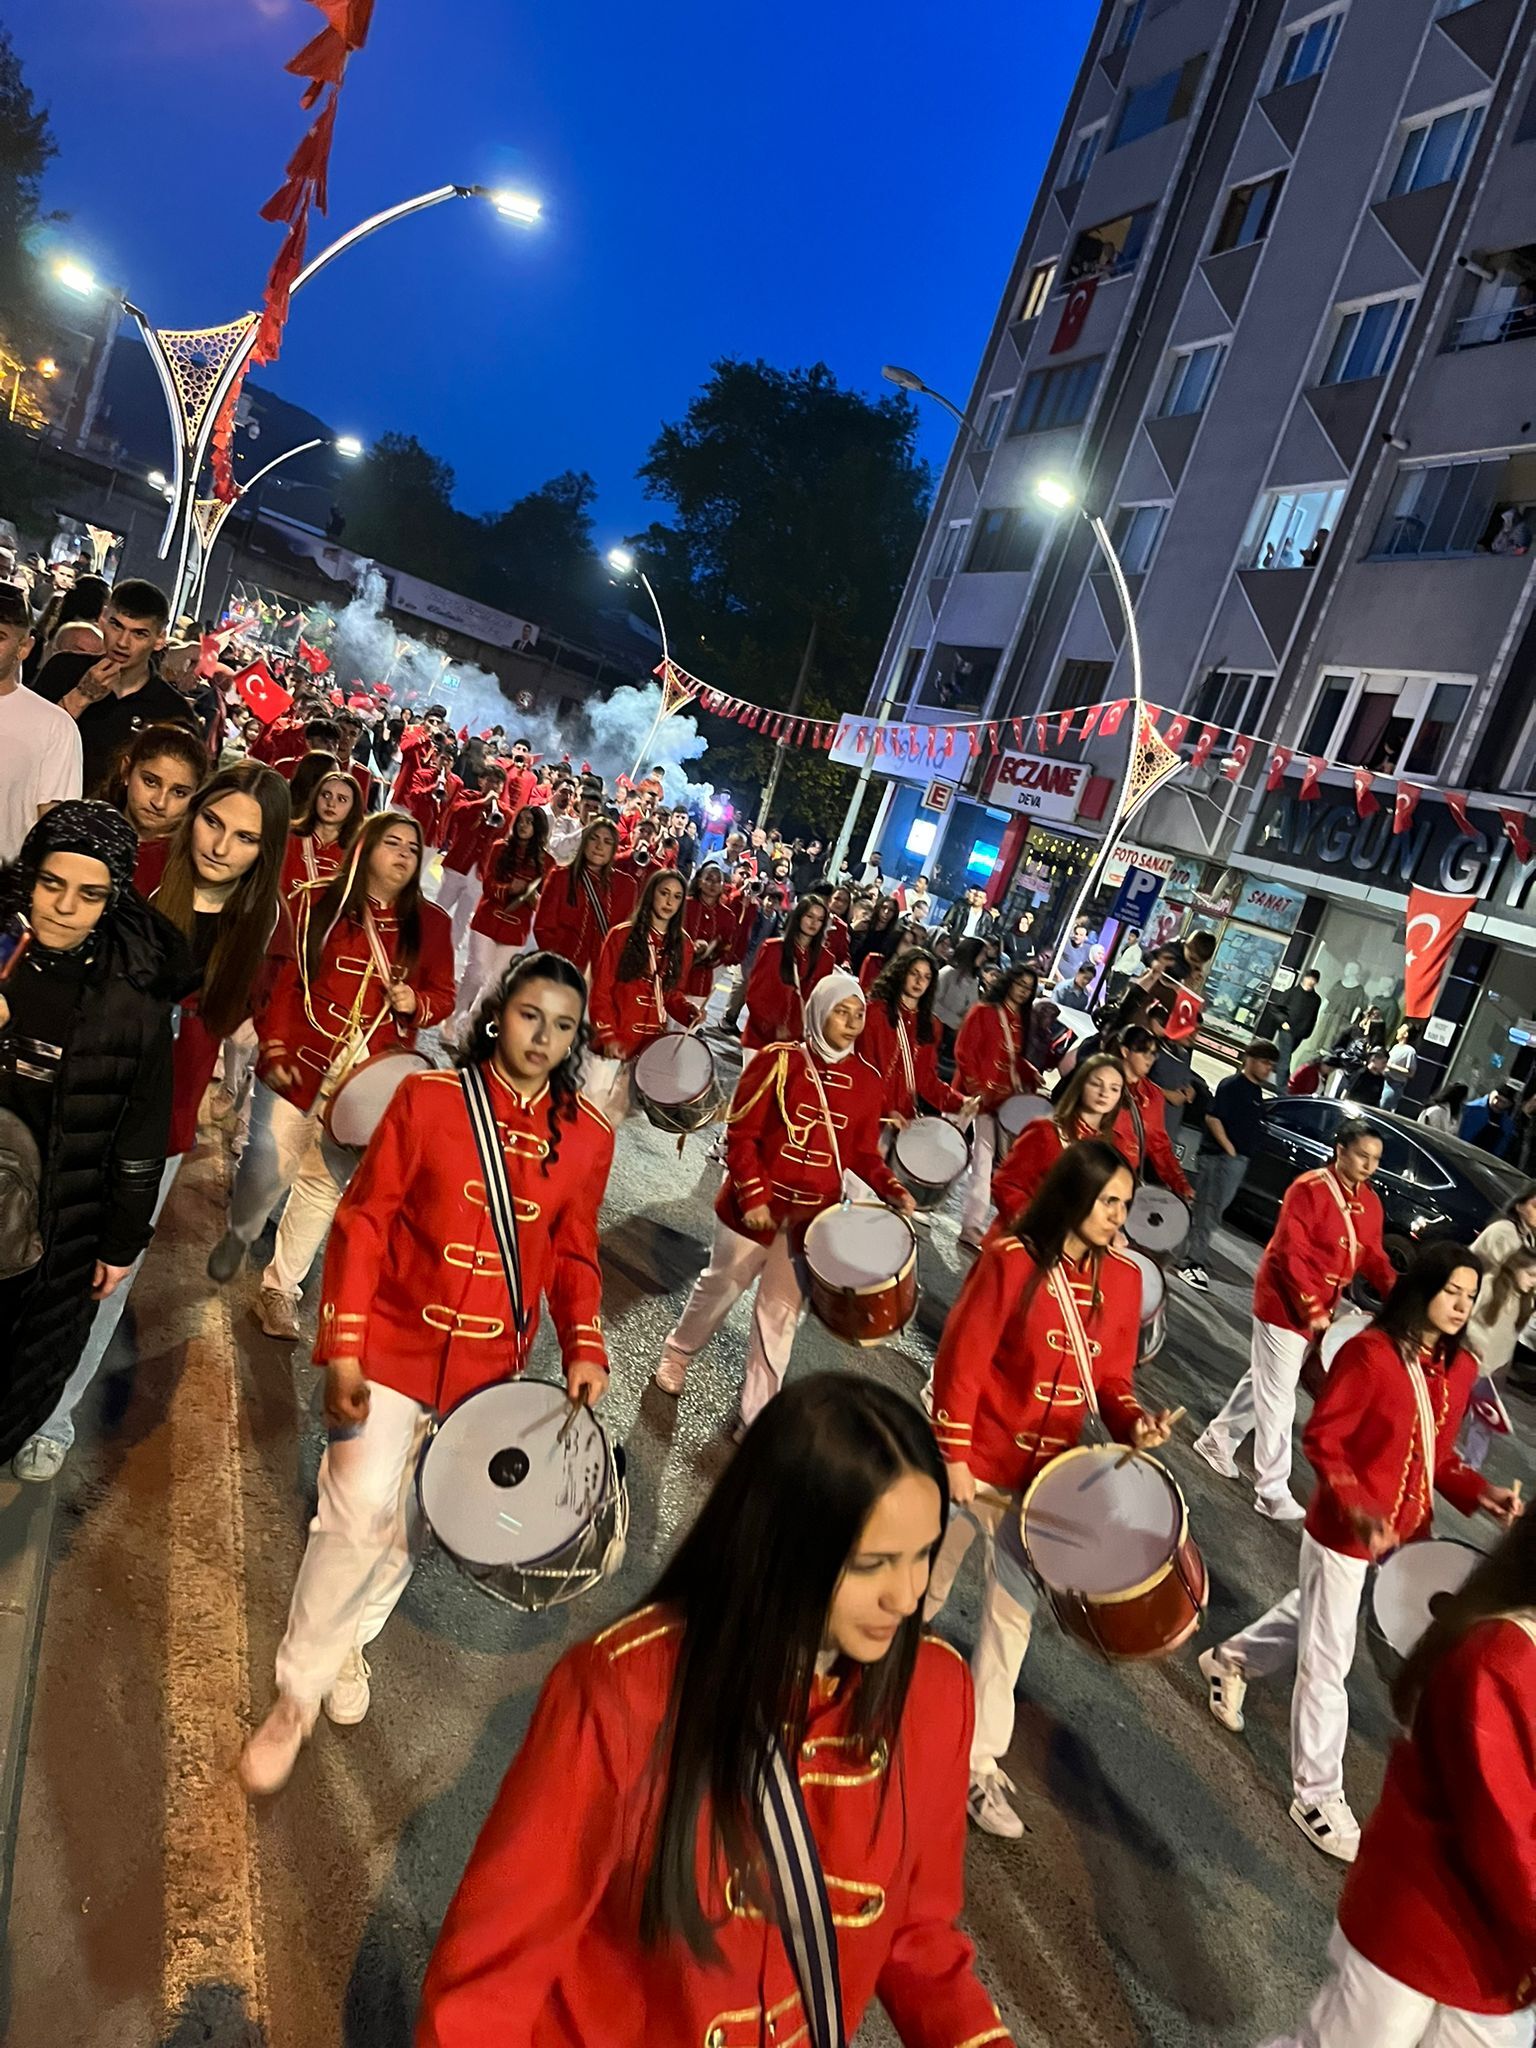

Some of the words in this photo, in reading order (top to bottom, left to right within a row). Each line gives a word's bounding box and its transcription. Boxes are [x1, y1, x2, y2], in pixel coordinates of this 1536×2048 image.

[998, 757, 1082, 797] ECZANE
[931, 785, 948, 807] E
[1017, 792, 1041, 808] DEVA
[1112, 847, 1138, 865] FOTO
[1139, 853, 1174, 873] SANAT
[1126, 869, 1156, 900] P
[1169, 868, 1191, 885] OTO
[1247, 890, 1293, 913] SANAT
